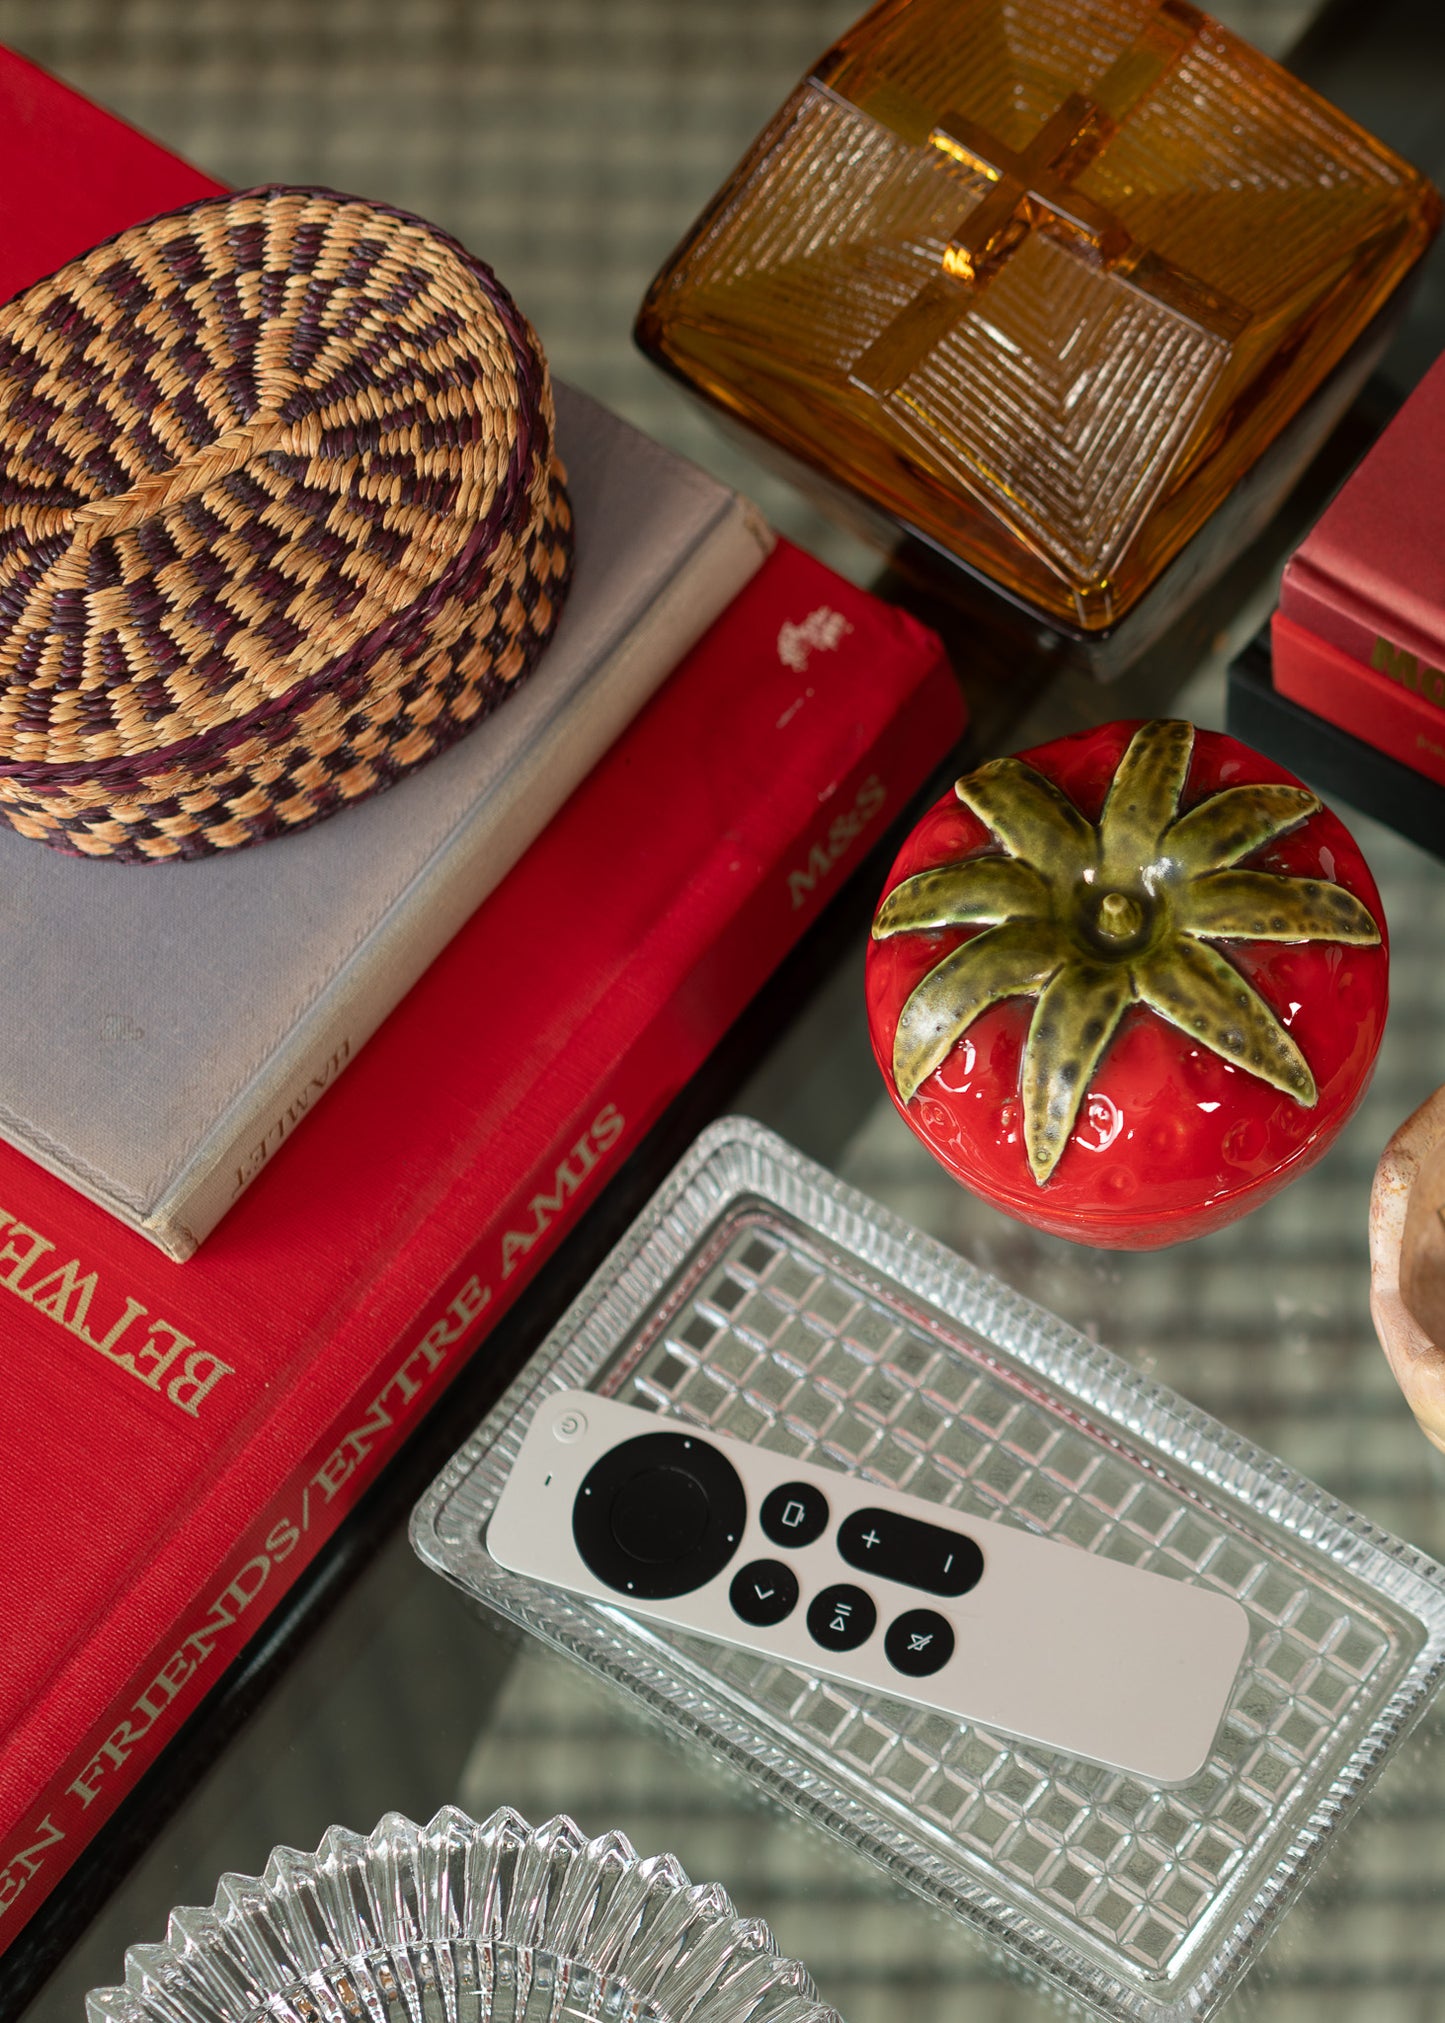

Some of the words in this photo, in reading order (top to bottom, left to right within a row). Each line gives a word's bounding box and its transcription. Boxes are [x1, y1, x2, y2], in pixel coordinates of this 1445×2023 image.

[787, 774, 886, 911] M&S
[232, 1040, 350, 1199] HAMLET
[501, 1103, 625, 1280] AMIS
[0, 1207, 236, 1418] BETWE
